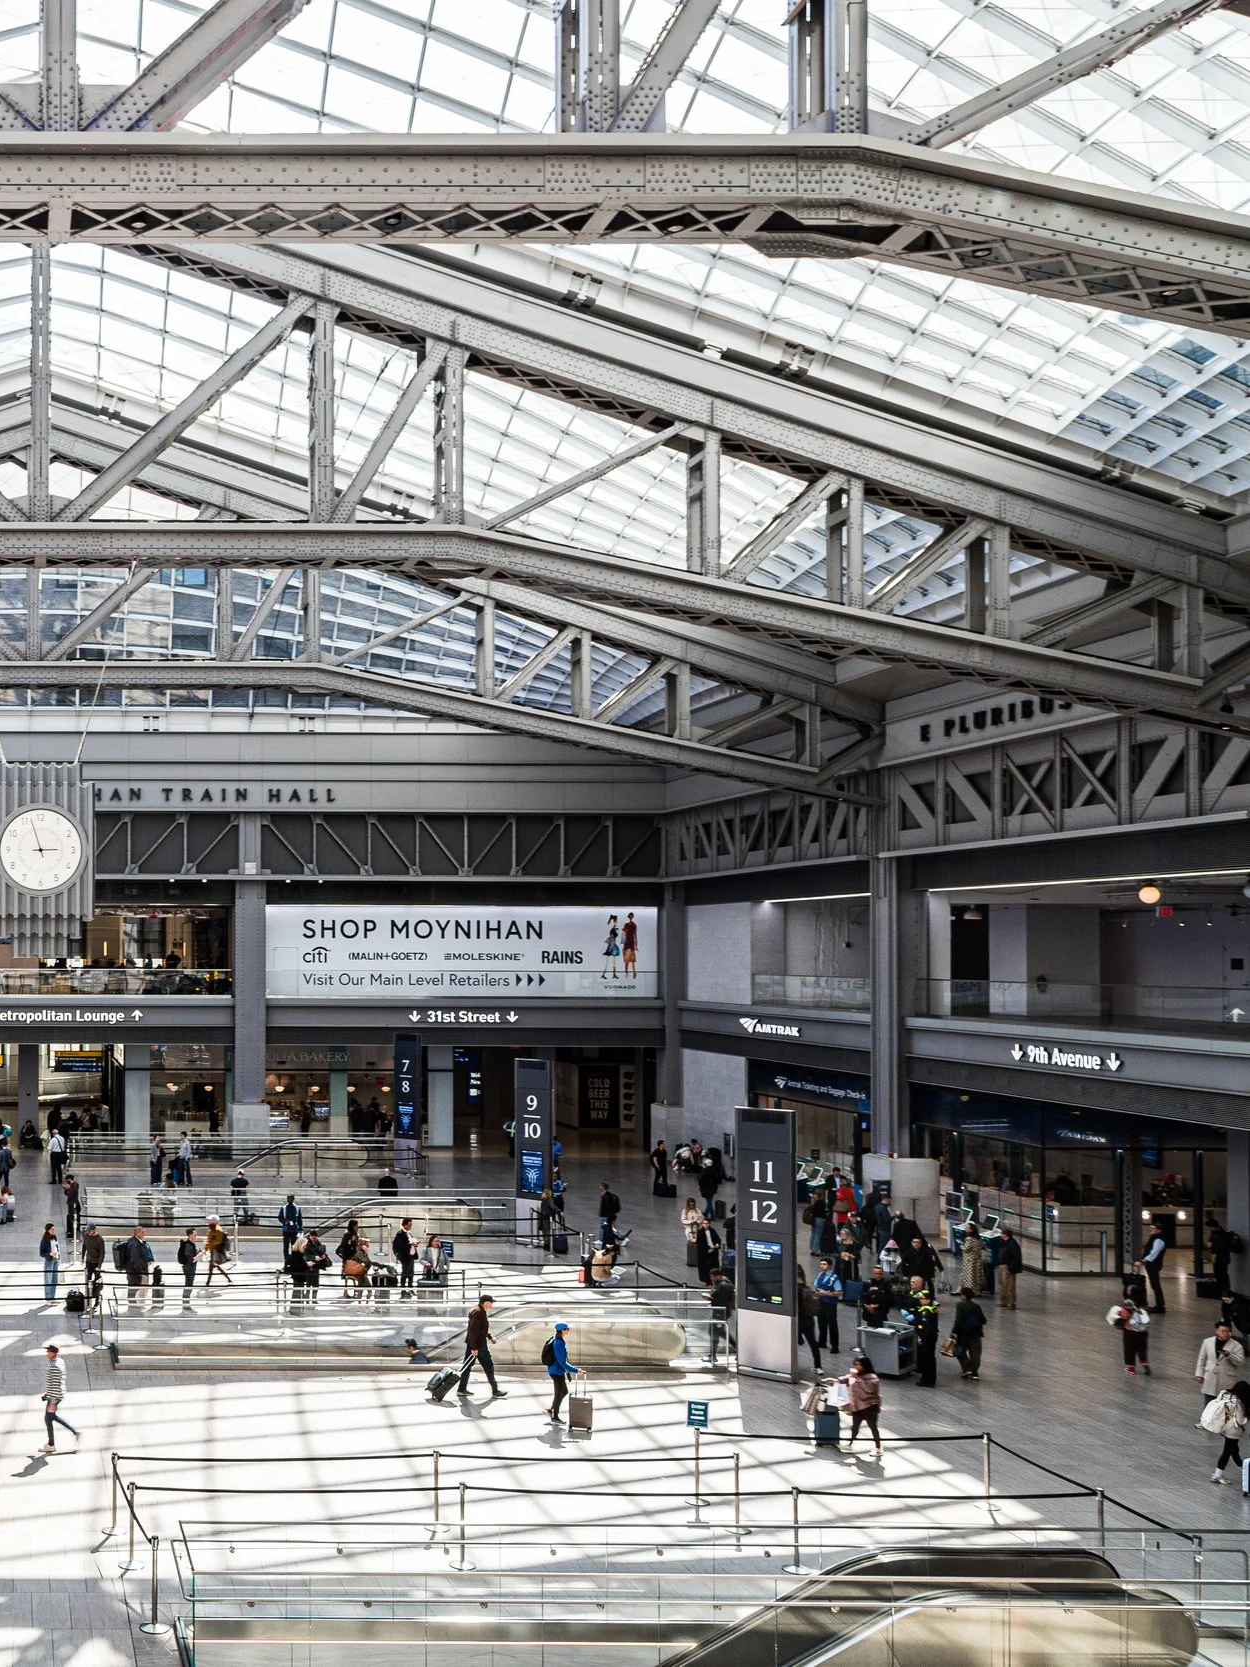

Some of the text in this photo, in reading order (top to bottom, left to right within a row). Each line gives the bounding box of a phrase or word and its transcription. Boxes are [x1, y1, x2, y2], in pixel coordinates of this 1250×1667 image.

[919, 724, 931, 742] E
[161, 787, 249, 802] TRAIN
[267, 788, 336, 803] HALL
[21, 817, 29, 826] 11
[36, 813, 45, 822] 12
[9, 829, 18, 838] 10
[66, 829, 72, 838] 2
[5, 845, 11, 854] 9
[70, 846, 76, 855] 3
[10, 861, 16, 870] 8
[21, 873, 27, 882] 7
[53, 873, 60, 882] 5
[302, 919, 544, 940] SHOP MOYNIHAN
[302, 947, 330, 963] citi
[348, 952, 428, 961] (MALIN+GOETZ)
[541, 950, 584, 965] RAINS
[302, 973, 511, 986] Visit Our Main Level Retailers
[75, 1009, 126, 1024] Lounge
[426, 1010, 501, 1023] 31st Street
[754, 1023, 800, 1037] AMTRAK
[300, 1052, 350, 1062] BAKERY
[1026, 1044, 1101, 1071] 9th Avenue
[401, 1060, 410, 1073] 7
[401, 1080, 411, 1093] 8
[587, 1078, 610, 1088] COLD
[587, 1089, 610, 1099] BEER
[526, 1095, 538, 1111] 9
[589, 1099, 609, 1109] THIS
[590, 1110, 608, 1120] WAY
[523, 1122, 542, 1139] 10
[752, 1160, 775, 1183] 11
[751, 1199, 778, 1224] 12
